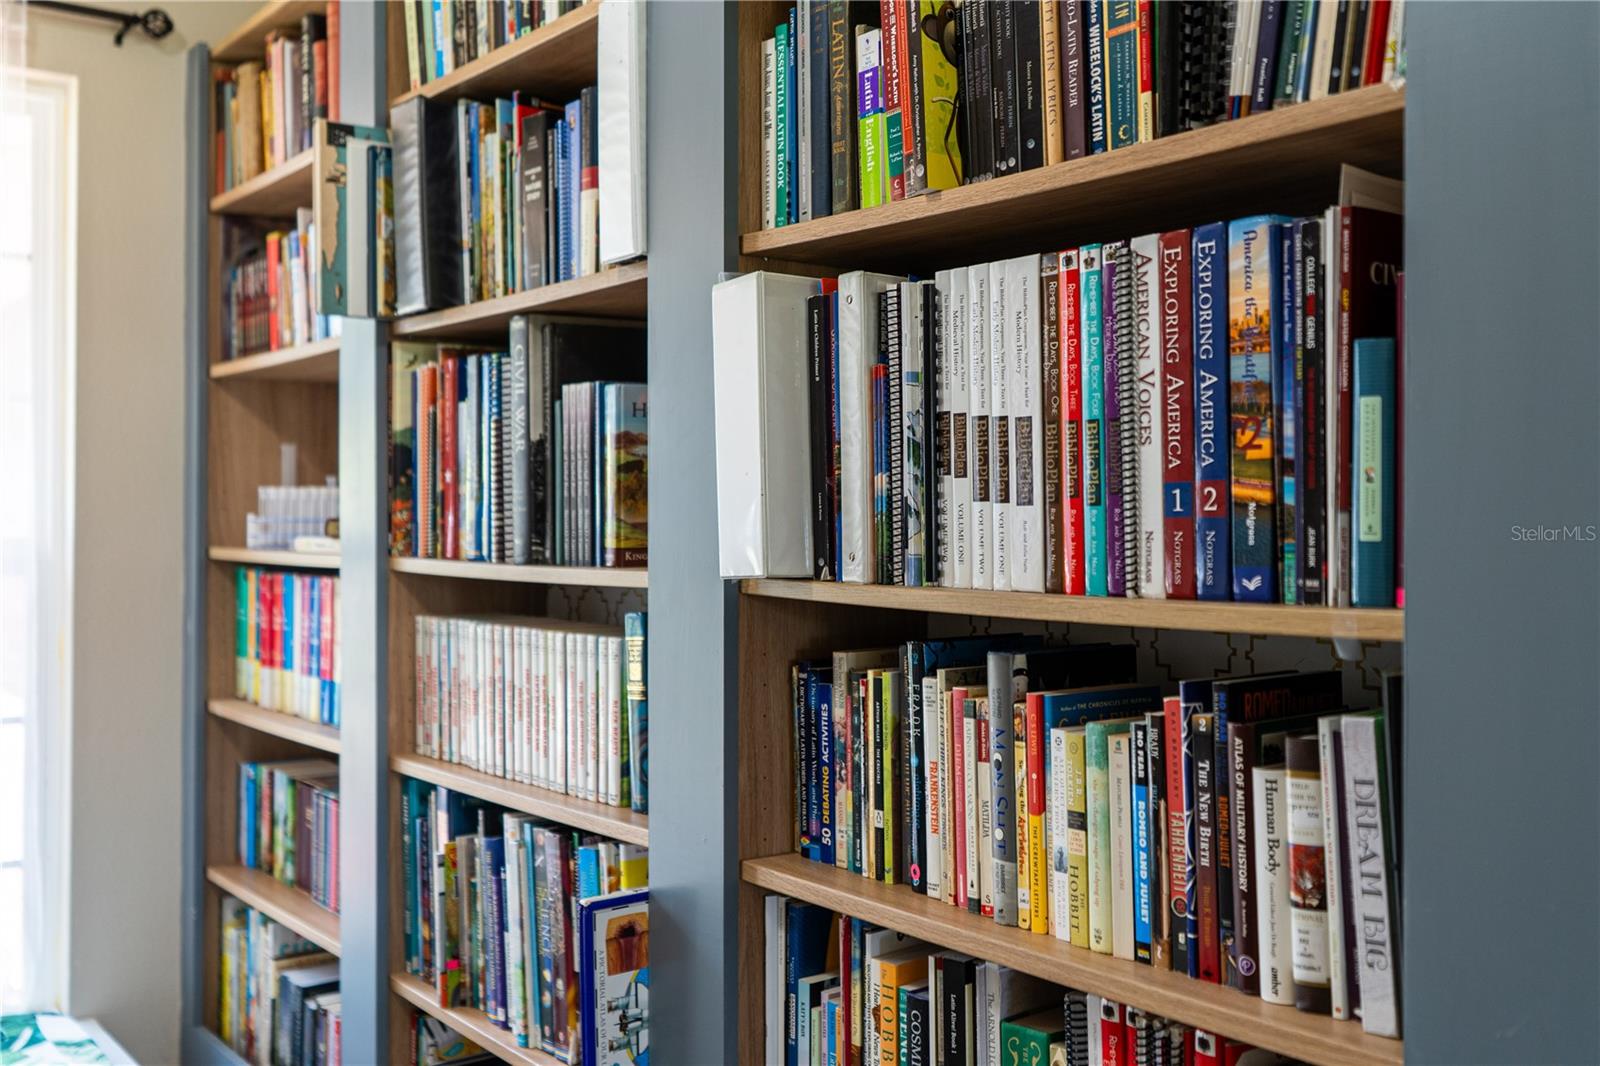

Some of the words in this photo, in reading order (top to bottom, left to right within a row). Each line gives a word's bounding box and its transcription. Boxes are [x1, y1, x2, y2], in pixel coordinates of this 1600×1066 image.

[832, 18, 845, 78] LATIN
[1066, 0, 1078, 56] EO-LATIN
[890, 24, 899, 78] WHEELOCK'S
[1046, 32, 1055, 71] LATIN
[1089, 24, 1103, 103] WHEELOCK'S
[1287, 53, 1299, 84] Longman
[777, 47, 785, 112] ESSENTIAL
[833, 81, 844, 95] for
[864, 70, 873, 110] Latin
[1068, 58, 1080, 108] READER
[834, 95, 843, 136] Americans
[1047, 79, 1056, 126] LYRICS
[1092, 104, 1103, 142] LATIN
[777, 114, 785, 149] LATIN
[864, 119, 875, 172] English
[777, 154, 785, 189] BOOK
[1243, 229, 1258, 292] America
[1306, 256, 1316, 296] COLLEGE
[1048, 282, 1058, 321] REMEMBER
[1067, 283, 1076, 320] REMEMBER
[1089, 275, 1099, 317] REMEMBER
[1136, 253, 1153, 360] AMERICAN
[1164, 245, 1182, 364] EXPLORING
[1198, 240, 1217, 360] EXPLORING
[1245, 297, 1257, 319] the
[1090, 320, 1098, 332] THE
[1306, 316, 1316, 349] GENIUS
[952, 349, 960, 376] History
[1015, 345, 1023, 376] History
[1048, 341, 1059, 365] DAYS,
[1068, 338, 1078, 360] DAYS,
[1089, 336, 1100, 362] DAYS,
[1105, 354, 1114, 373] DAYS
[514, 344, 525, 400] CIVIL
[1050, 368, 1058, 392] BOOK
[1069, 363, 1077, 386] BOOK
[1091, 364, 1099, 389] BOOK
[1051, 395, 1060, 416] ONE
[1069, 389, 1078, 411] THREE
[1092, 392, 1101, 416] FOUR
[1138, 369, 1155, 446] VOICES
[1199, 369, 1218, 468] AMERICA
[514, 404, 526, 452] WAR
[1166, 373, 1184, 469] AMERICA
[956, 416, 967, 476] BiblioPlan
[976, 418, 988, 499] BiblioPlan
[997, 418, 1009, 501] BiblioPlan
[1018, 420, 1032, 503] BiblioPlan
[1046, 422, 1060, 502] BiblioPlan
[1066, 422, 1078, 497] BiblioPlan
[1086, 421, 1100, 504] BiblioPlan
[1109, 421, 1121, 493] BiblioPlan
[1172, 488, 1184, 512] 1
[1203, 486, 1218, 512] 2
[1246, 502, 1257, 545] Notgrass
[1308, 526, 1317, 546] JEAN
[1145, 531, 1154, 584] NOTGRASS
[1174, 530, 1183, 585] NOTGRASS
[1206, 530, 1215, 586] NOTGRASS
[1308, 548, 1317, 568] BURK
[820, 703, 829, 763] ACTIVITIES
[1137, 730, 1144, 747] NO
[1150, 728, 1160, 759] BRADY
[1198, 718, 1207, 732] 2
[1137, 750, 1145, 778] FEAR
[1198, 759, 1210, 787] THE
[1234, 736, 1244, 770] ATLAS
[821, 765, 830, 824] DEBATING
[930, 761, 939, 835] FRANKENSTEIN
[1235, 772, 1244, 788] OF
[982, 800, 990, 838] MATILDA
[1138, 801, 1148, 848] ROMEO
[1198, 792, 1211, 823] NEW
[1218, 796, 1229, 830] ROMEO
[1235, 790, 1247, 843] MILITARY
[1264, 778, 1279, 834] Human
[821, 827, 832, 847] 50
[1170, 811, 1186, 892] FAHRENHEIT
[1199, 826, 1212, 867] BIRTH
[1219, 835, 1231, 868] JULIET
[1264, 838, 1280, 876] Body
[1353, 777, 1384, 898] DREAM
[1139, 850, 1148, 880] AND
[1237, 844, 1248, 892] HISTORY
[1070, 865, 1080, 933] HOBBIT
[1140, 882, 1149, 924] JULIET
[1363, 914, 1389, 972] BIG
[1271, 967, 1281, 997] amber
[882, 984, 894, 1062] HOBB
[911, 1010, 921, 1066] COSMI
[988, 1010, 996, 1054] ARNOLD
